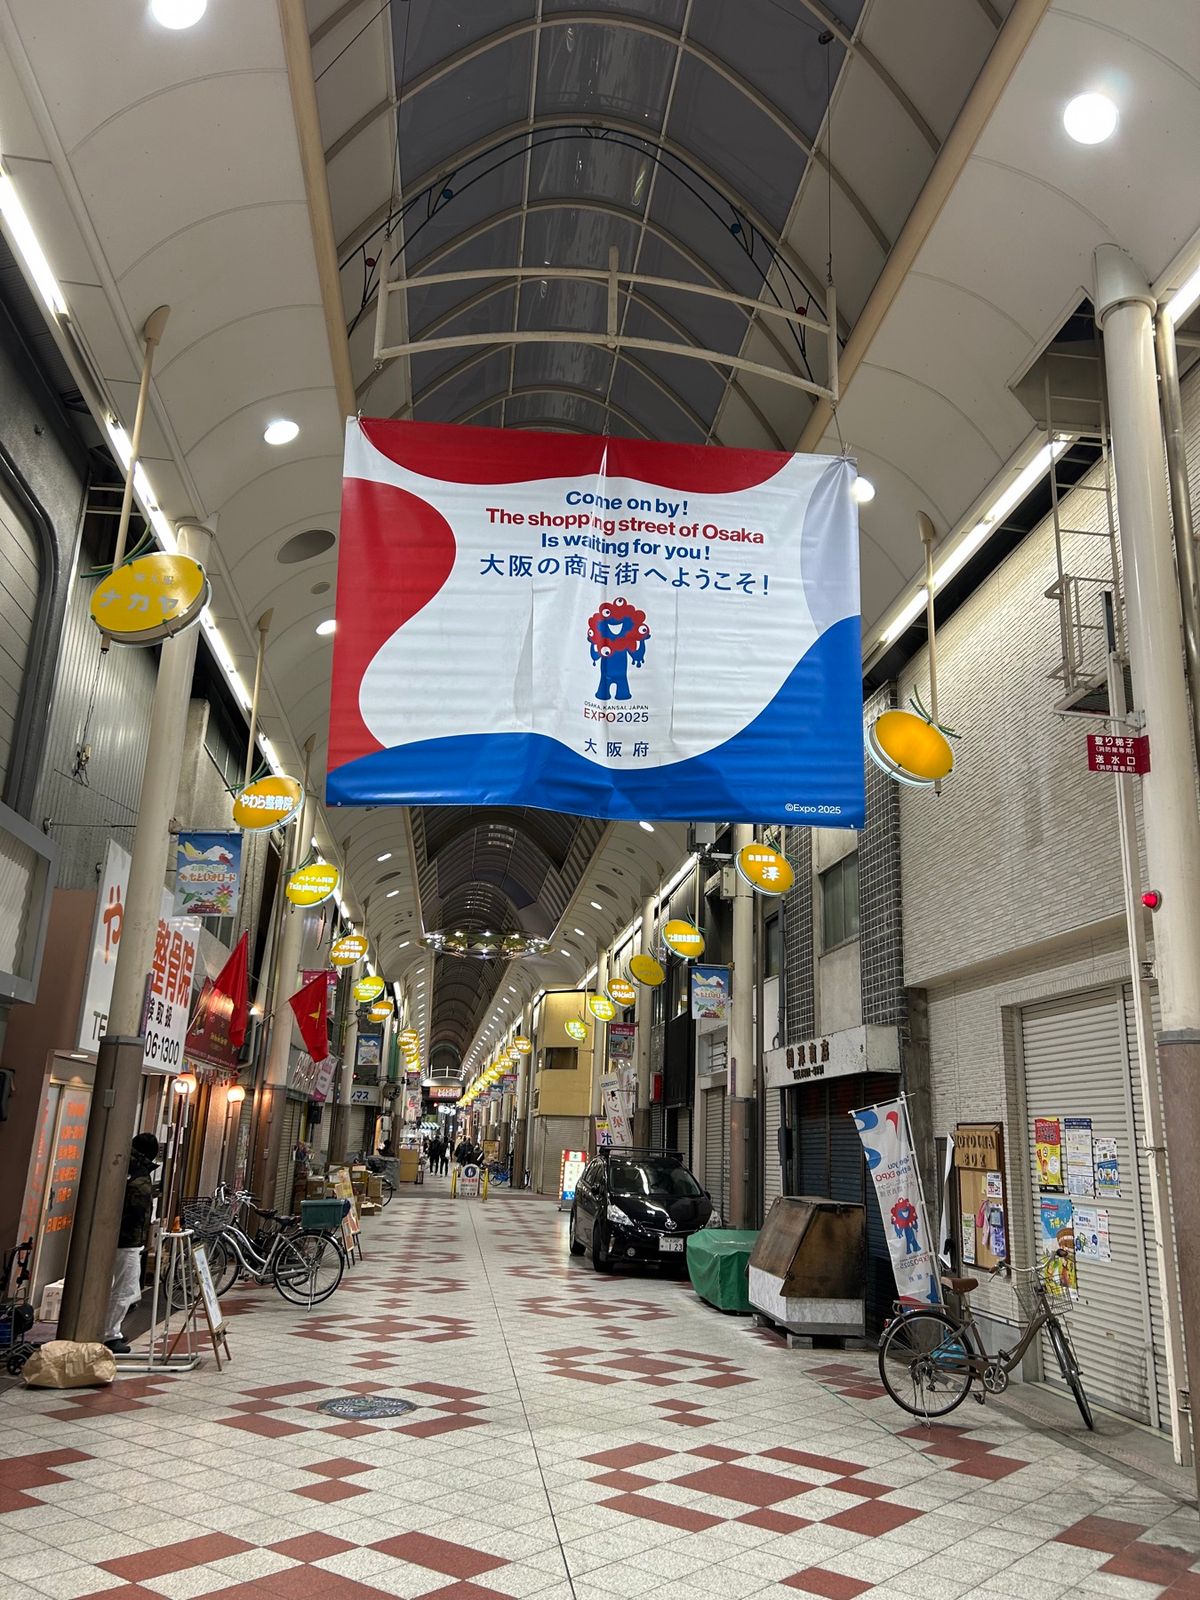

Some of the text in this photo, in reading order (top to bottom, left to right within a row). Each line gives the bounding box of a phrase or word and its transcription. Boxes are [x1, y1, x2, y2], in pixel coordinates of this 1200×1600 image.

[566, 491, 622, 510] Come
[626, 499, 652, 511] on
[485, 508, 764, 544] The shopping street of Osaka
[541, 533, 559, 548] Is
[563, 534, 629, 557] waiting
[632, 538, 661, 555] for
[100, 589, 179, 615] ナカヤ
[583, 707, 649, 723] EXPO2025
[584, 738, 649, 758] 大阪府
[1095, 754, 1136, 766] 送水口
[240, 793, 294, 811] やわら整骨院
[817, 805, 841, 816] 2025
